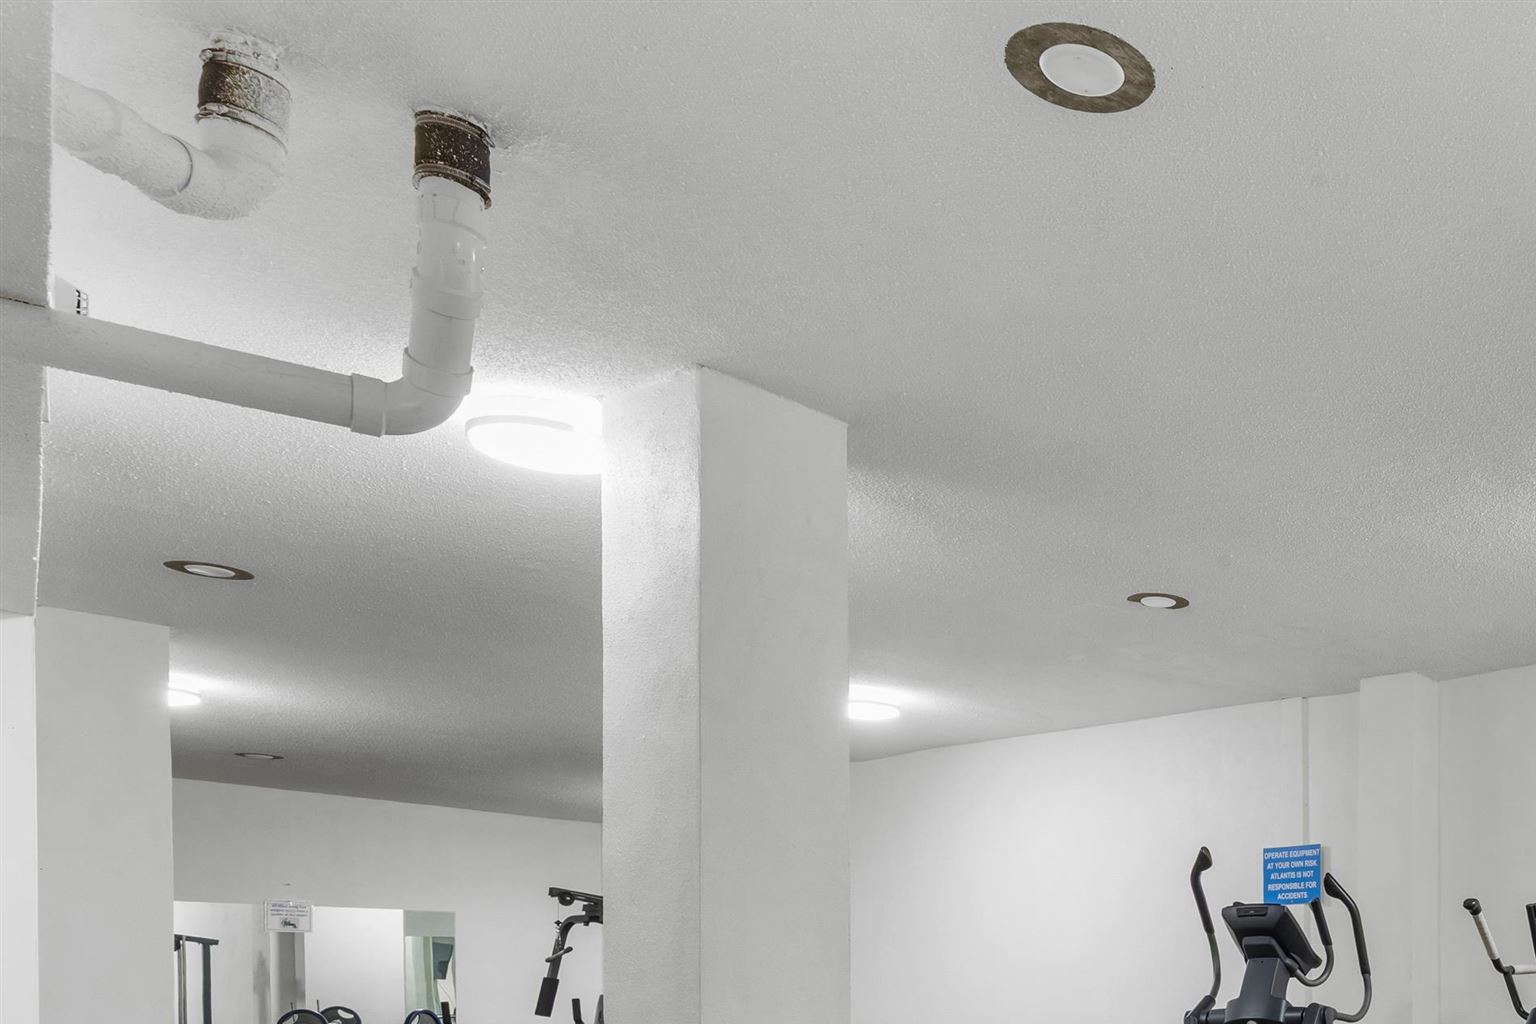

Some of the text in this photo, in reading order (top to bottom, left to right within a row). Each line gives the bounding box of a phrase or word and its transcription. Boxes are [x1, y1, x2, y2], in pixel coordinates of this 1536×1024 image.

[1264, 848, 1320, 860] OPERATE EQUIPMENT
[1270, 872, 1296, 880] ATLANTIS
[1268, 882, 1304, 891] RESPONSIBLE
